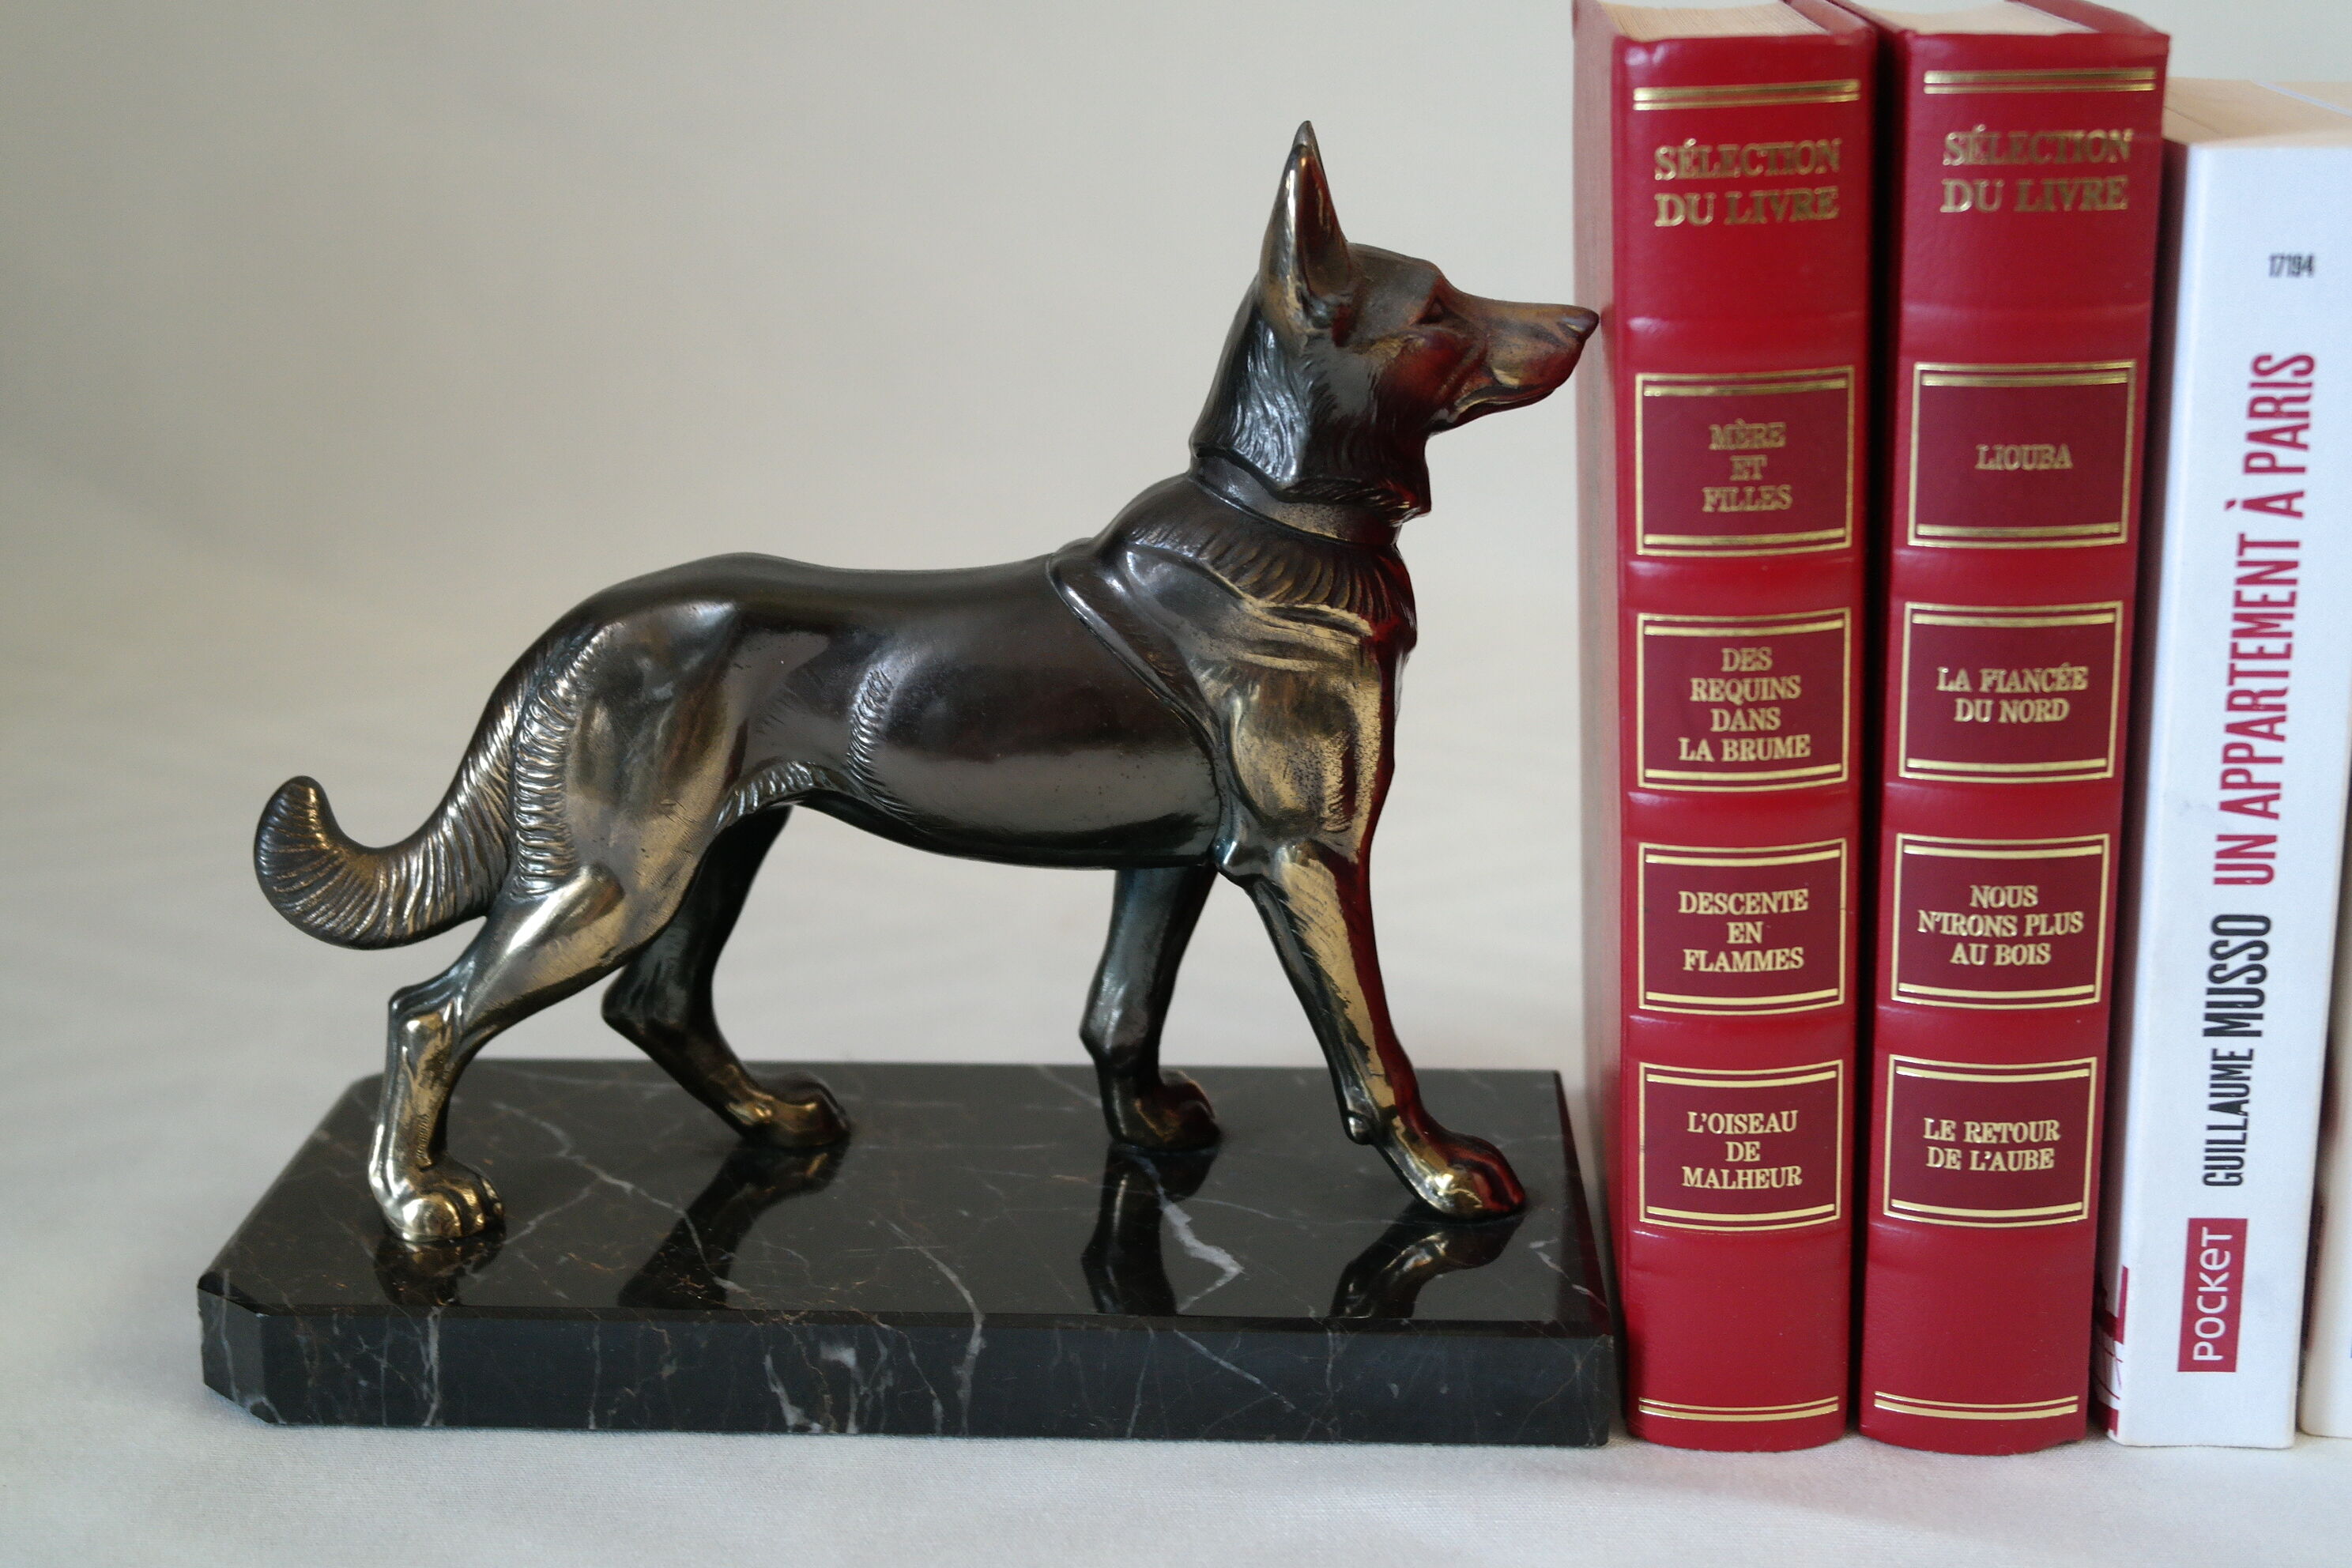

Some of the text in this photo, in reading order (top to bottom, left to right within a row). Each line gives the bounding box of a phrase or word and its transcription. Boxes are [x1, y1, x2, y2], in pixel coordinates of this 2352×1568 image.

[1943, 124, 2134, 166] SÉLECTION
[1655, 138, 1842, 180] SÉLECTION
[1655, 186, 1840, 227] DU LIVRE
[1939, 175, 2128, 213] DU LIVRE
[2268, 253, 2316, 280] 17194
[1709, 419, 1786, 450] MÈRE
[1729, 454, 1767, 481] ET
[1976, 443, 2072, 470] LIOUBA
[1702, 484, 1792, 512] FILLES
[2213, 352, 2317, 886] UN APPARTEMENT À PARIS
[1721, 646, 1773, 673] DES
[1690, 675, 1801, 703] REQUINS
[1937, 662, 2089, 693] LA FIANCÉE
[1711, 707, 1781, 733] DANS
[1954, 697, 2069, 723] DU NORD
[1679, 734, 1811, 762] LA BRUME
[1679, 888, 1809, 916] DESCENTE
[1970, 885, 2038, 910] NOUS
[1728, 922, 1763, 944] EN
[1917, 910, 2084, 937] N'IRONS PLUS
[1683, 947, 1804, 973] FLAMMES
[1950, 943, 2052, 967] AU BOIS
[2203, 914, 2273, 1187] GUILLAUME MUSSO
[1687, 1110, 1798, 1136] L'OISEAU
[1923, 1118, 2061, 1144] LE RETOUR
[1725, 1140, 1761, 1163] DE
[1926, 1148, 2055, 1172] DE L'AUBE
[1682, 1166, 1803, 1191] MALHEUR
